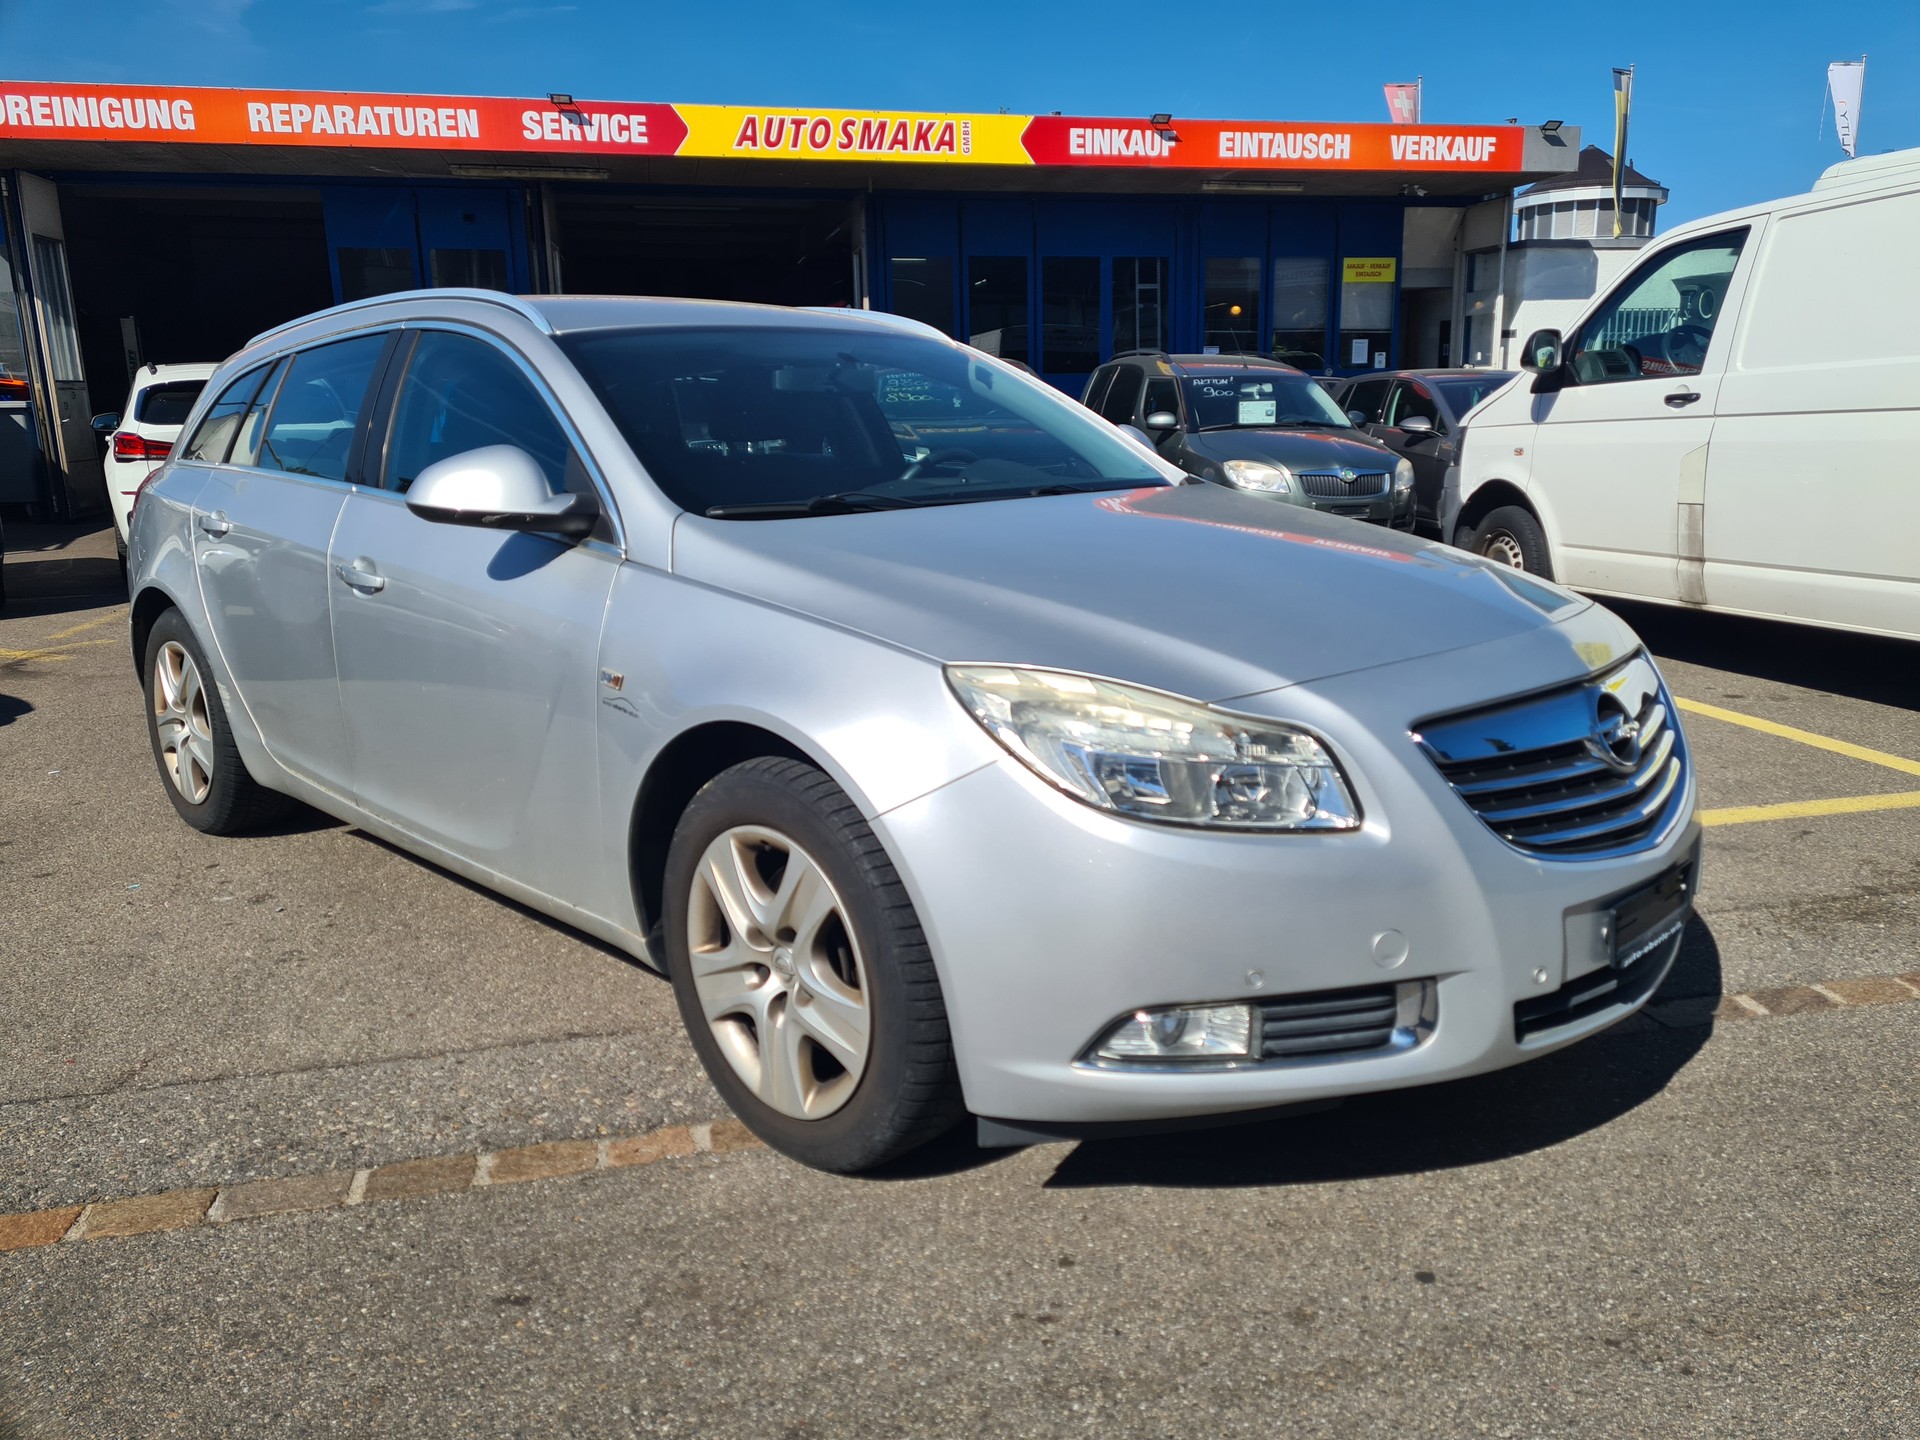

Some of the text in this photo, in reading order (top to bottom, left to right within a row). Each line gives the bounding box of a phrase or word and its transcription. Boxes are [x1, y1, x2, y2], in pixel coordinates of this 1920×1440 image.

[247, 102, 479, 138] REPARATUREN
[521, 110, 649, 143] SERVICE
[734, 115, 957, 152] AUTO SMAKA
[961, 121, 971, 155] GMBH
[1069, 128, 1177, 157] EINKAUF
[1219, 131, 1352, 160] EINTAUSCH
[1390, 135, 1498, 162] VERKAUF
